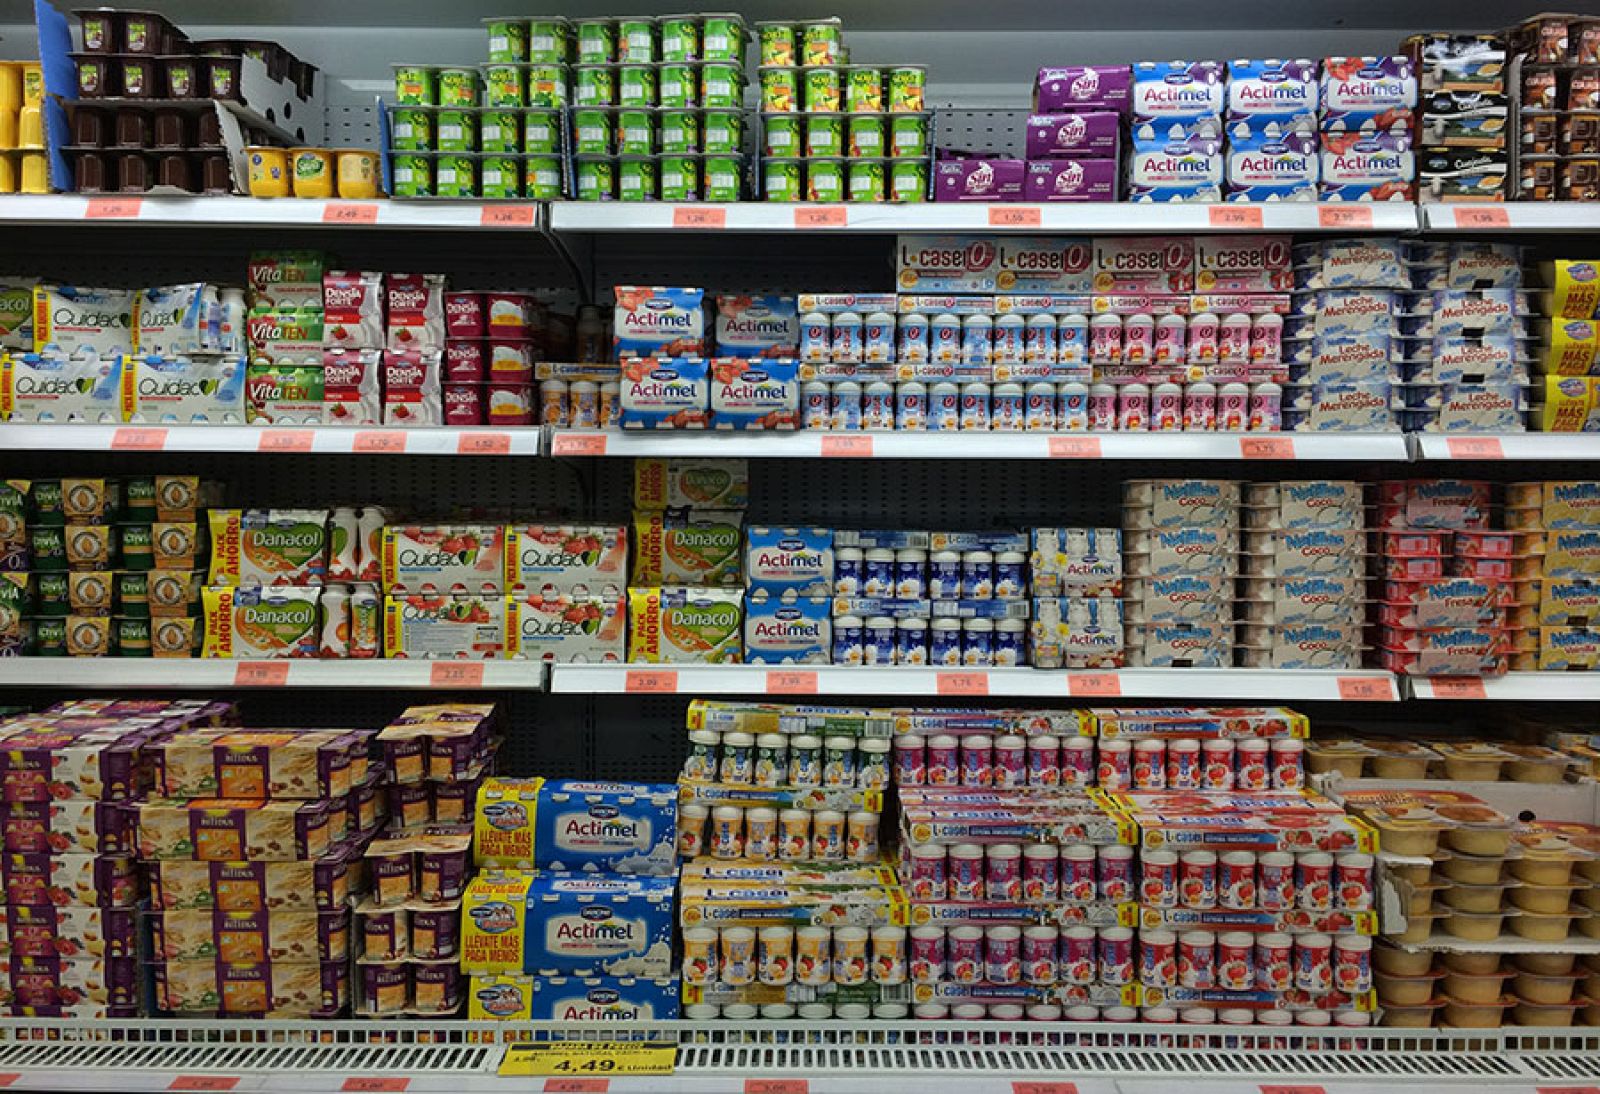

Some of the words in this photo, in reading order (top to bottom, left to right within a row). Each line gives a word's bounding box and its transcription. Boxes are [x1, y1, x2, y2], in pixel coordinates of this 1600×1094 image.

[1144, 86, 1211, 101] Actimel
[1239, 84, 1306, 99] Actimel
[1337, 81, 1405, 96] Actimel
[1143, 157, 1210, 172] Actimel
[1240, 157, 1307, 172] Actimel
[1333, 154, 1401, 170] Actimel
[252, 266, 281, 283] Vita
[1323, 302, 1388, 317] Merengada
[625, 311, 692, 327] Actimel
[251, 322, 282, 341] Vita
[283, 323, 310, 340] TEN
[725, 320, 790, 334] Actimel
[1338, 343, 1371, 355] Leche
[1319, 350, 1384, 366] Merengada
[251, 381, 281, 400] Vita
[282, 383, 310, 401] TEN
[630, 383, 697, 398] Actimel
[720, 384, 788, 400] Actimel
[1338, 391, 1371, 403] Leche
[1467, 391, 1499, 403] Leche
[1319, 397, 1385, 412] Merengada
[1450, 397, 1512, 412] Merengada
[1178, 497, 1206, 506] Coco
[1306, 498, 1333, 508] Coco
[226, 517, 239, 575] AHORRO
[253, 532, 319, 547] Danacol
[650, 517, 663, 574] AHORRO
[674, 531, 734, 546] Danacol
[1174, 545, 1203, 554] Coco
[1301, 547, 1330, 556] Coco
[758, 553, 823, 568] Actimel
[1169, 593, 1197, 602] Coco
[1301, 594, 1330, 603] Coco
[219, 593, 232, 652] AHORRO
[244, 609, 310, 624] Danacol
[671, 611, 735, 626] Danacol
[646, 595, 659, 654] AHORRO
[755, 622, 820, 637] Actimel
[1171, 639, 1200, 649] Coco
[1299, 641, 1328, 650] Coco
[565, 819, 638, 838] Actimel
[557, 922, 633, 940] Actimel
[564, 1006, 638, 1020] Actimel
[553, 1059, 616, 1072] 4,49
